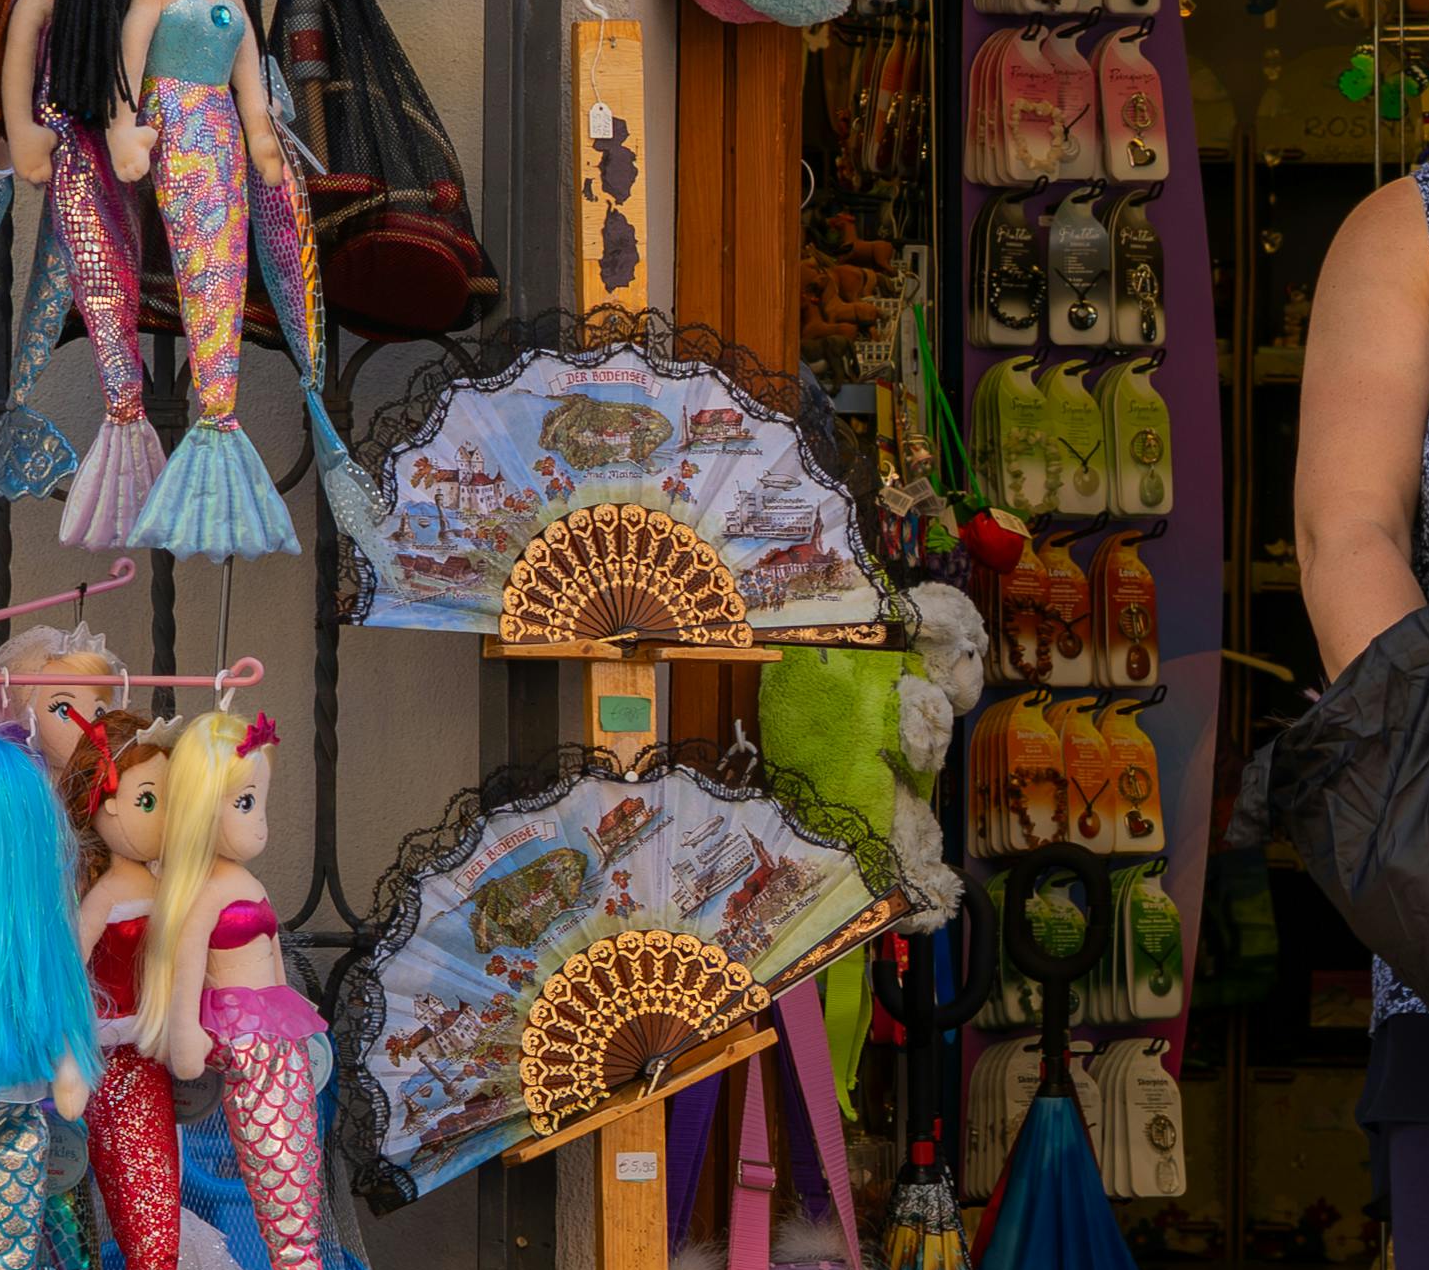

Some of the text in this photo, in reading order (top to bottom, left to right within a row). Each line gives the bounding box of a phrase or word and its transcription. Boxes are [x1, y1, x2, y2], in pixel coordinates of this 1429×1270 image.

[565, 369, 648, 386] DER BODENSEE
[465, 825, 539, 883] DER BODENSEE
